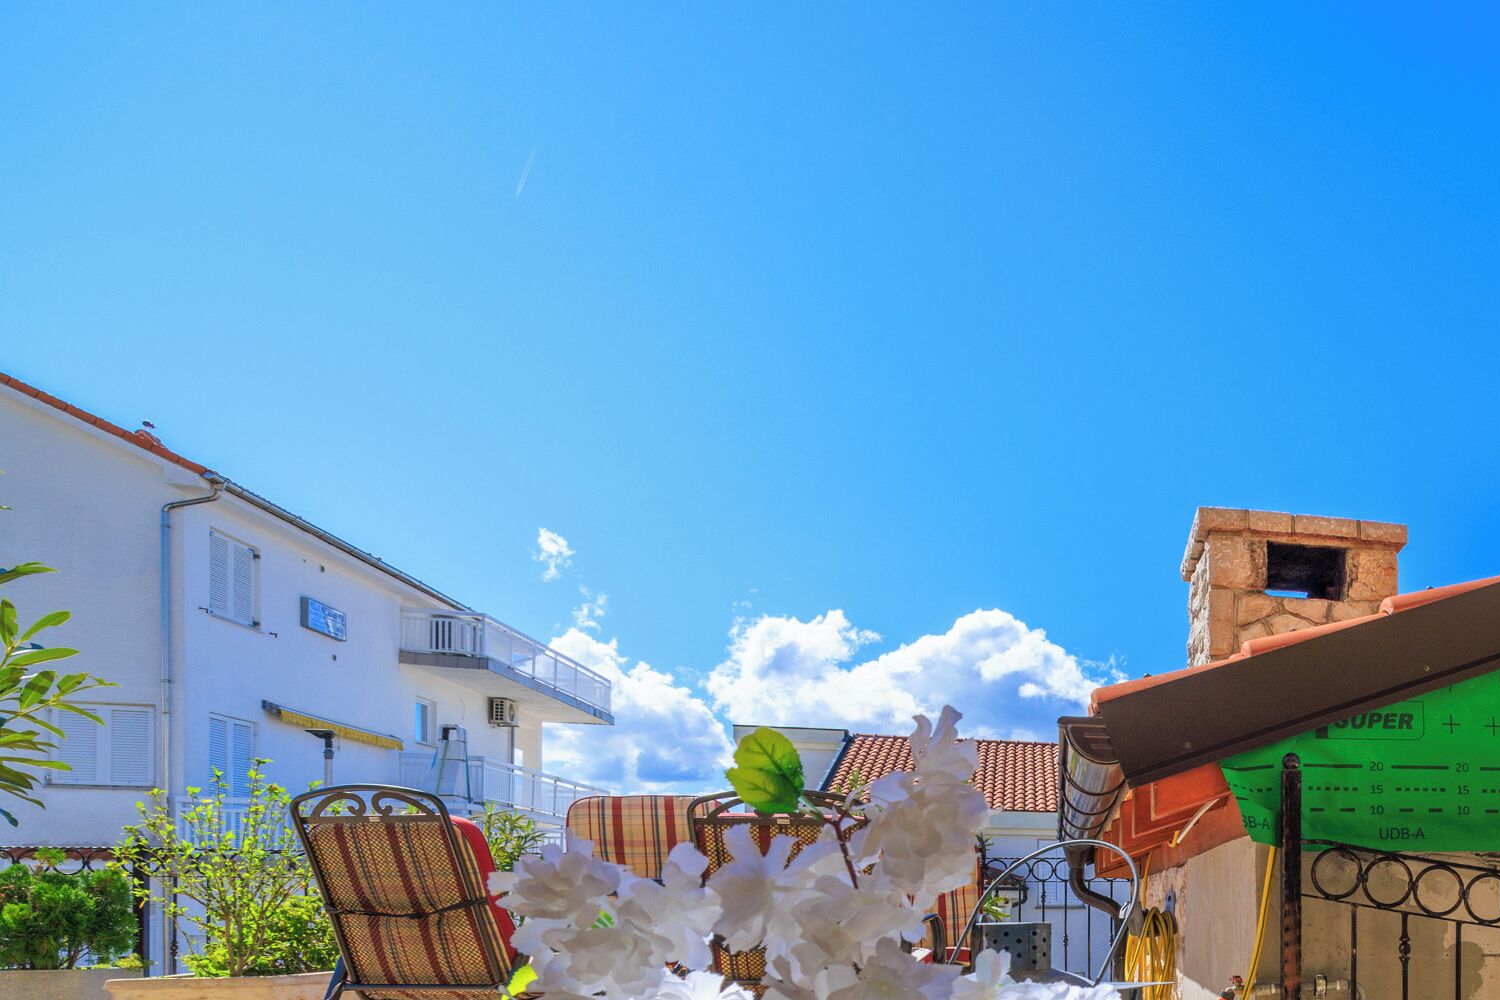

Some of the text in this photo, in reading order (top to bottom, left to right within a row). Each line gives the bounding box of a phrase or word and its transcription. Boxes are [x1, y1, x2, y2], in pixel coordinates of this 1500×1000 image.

[1369, 761, 1384, 772] 20
[1455, 763, 1469, 773] 20
[1370, 785, 1384, 795] 15
[1457, 786, 1470, 796] 15
[1370, 805, 1384, 815] 10
[1457, 806, 1470, 816] 10
[1379, 827, 1425, 841] UDB-A
